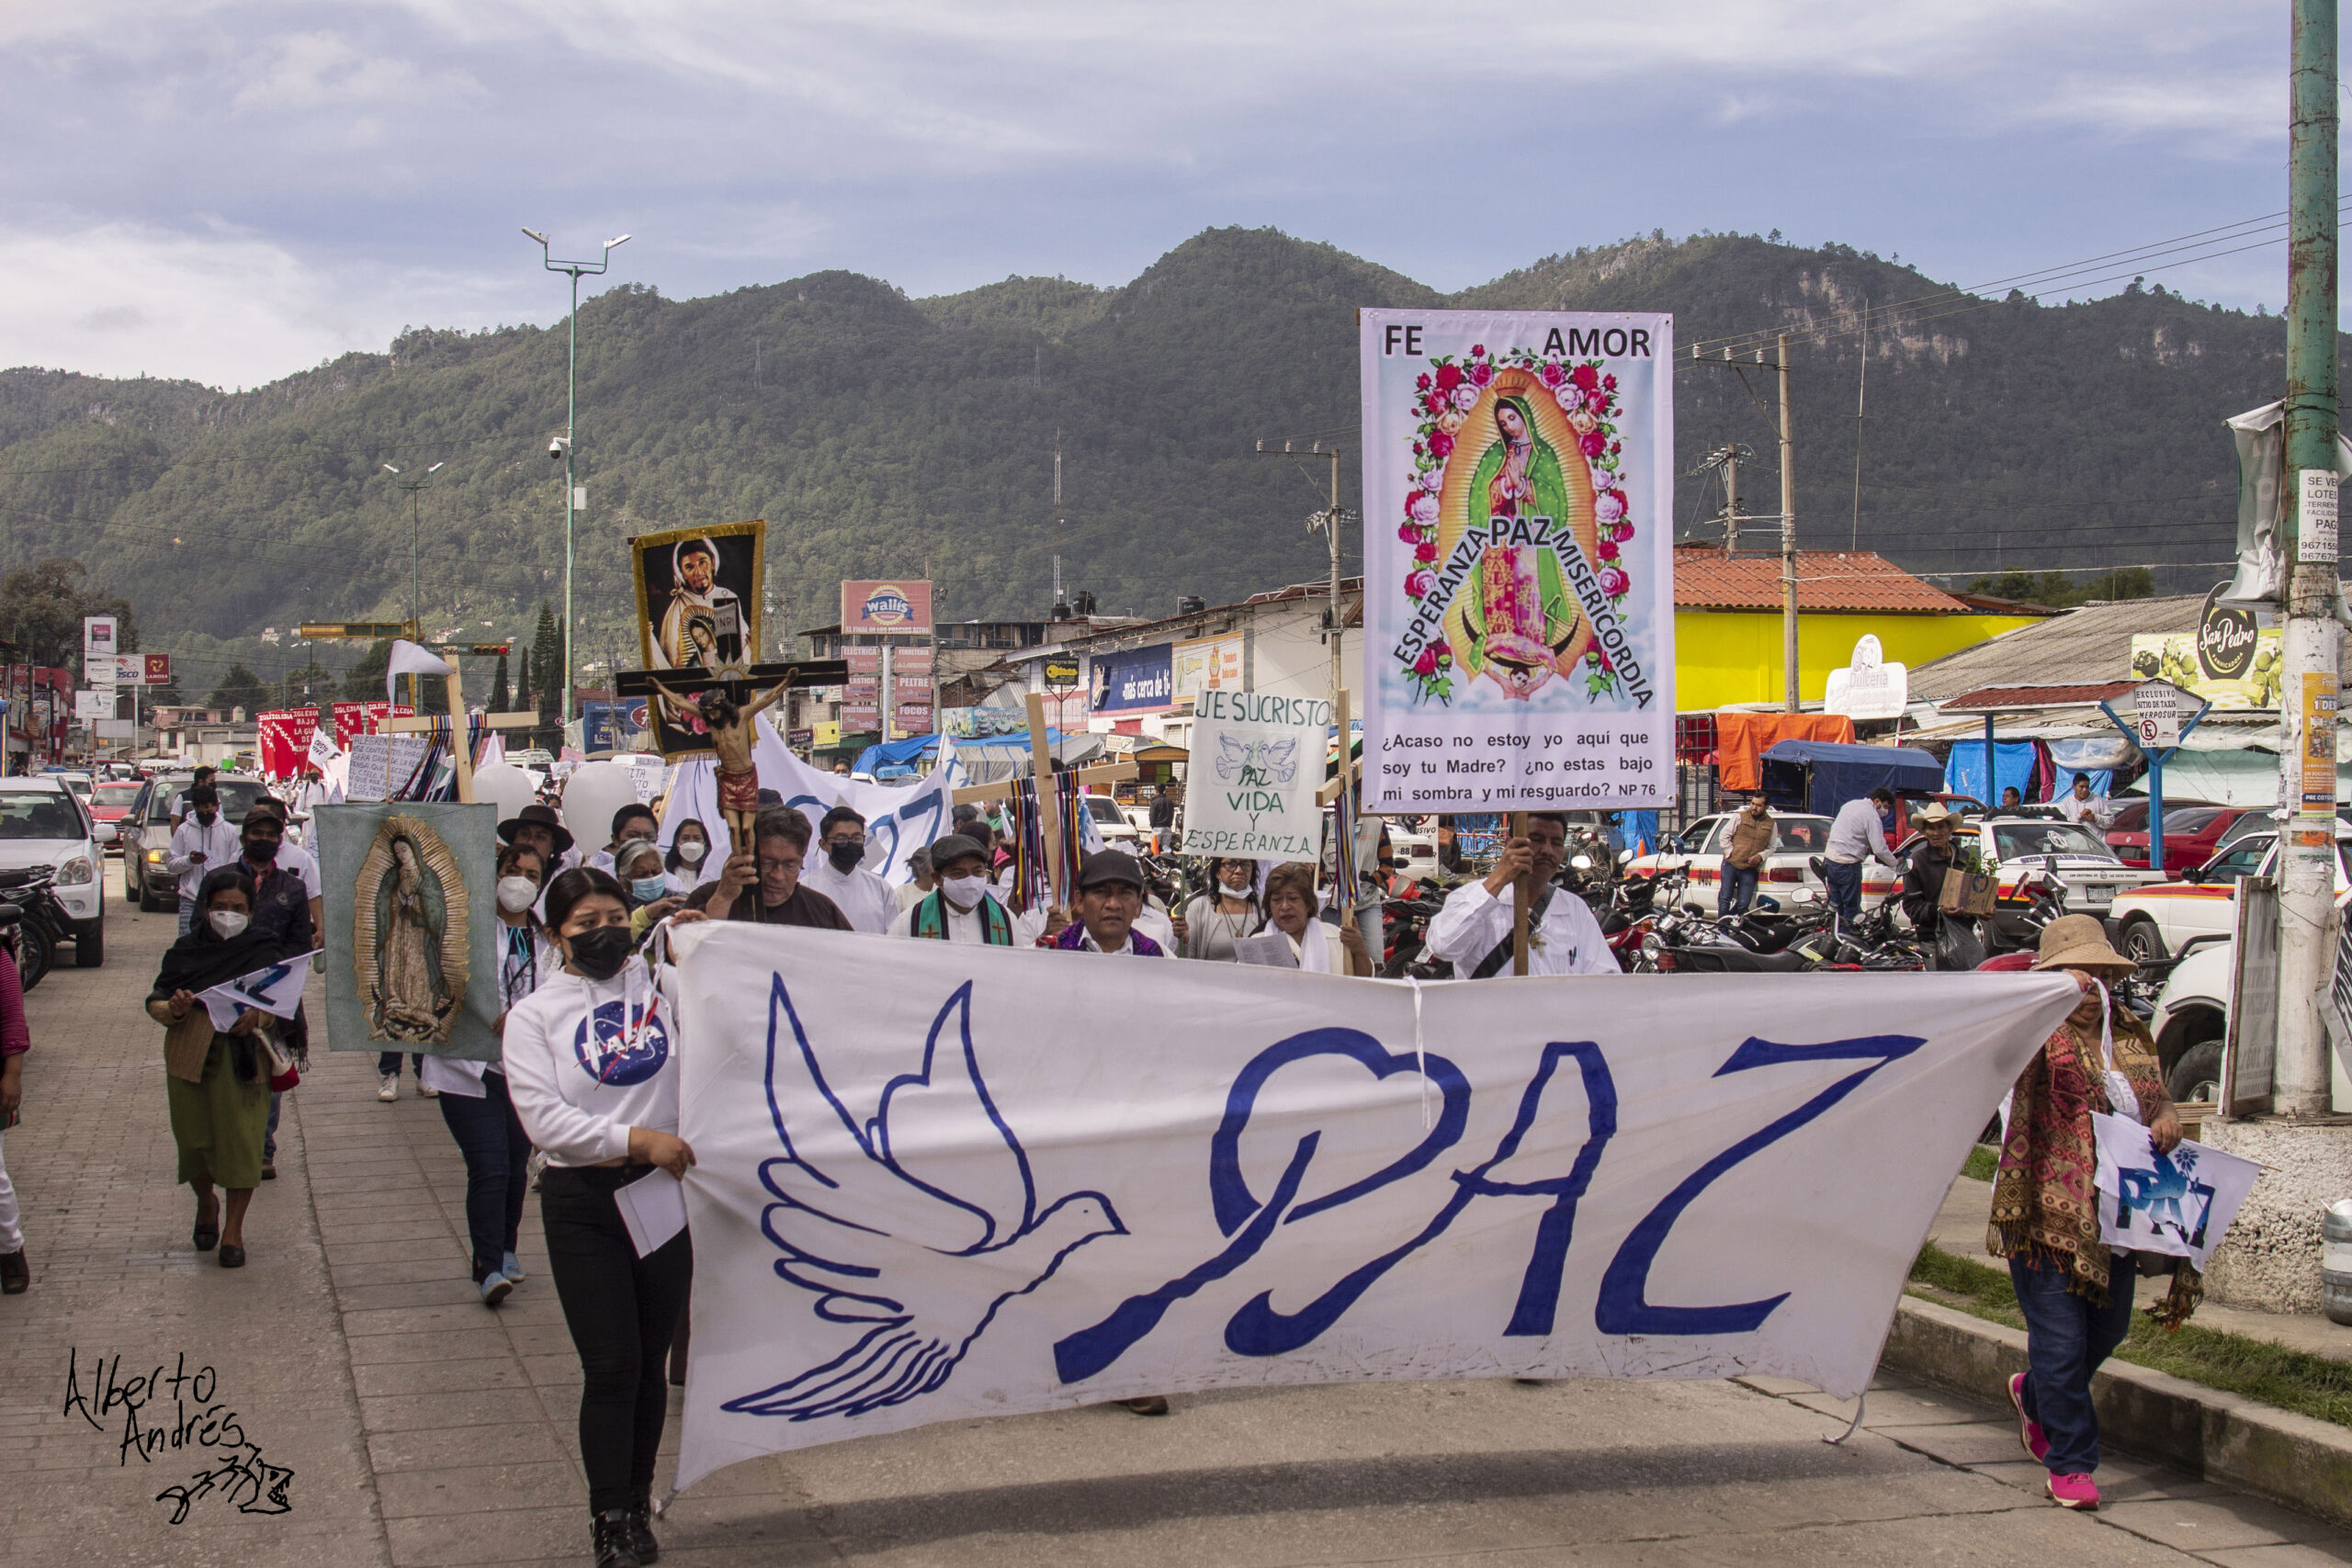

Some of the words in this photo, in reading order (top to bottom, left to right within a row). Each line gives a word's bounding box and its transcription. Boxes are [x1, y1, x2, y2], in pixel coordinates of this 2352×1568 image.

[1385, 325, 1423, 355] FE
[1543, 327, 1651, 357] AMOR
[2308, 476, 2323, 486] SE
[1490, 518, 1552, 546] PAZ
[1393, 526, 1489, 667] ESPERANZA
[1551, 530, 1655, 711] MISERICORDIA
[2199, 623, 2222, 651] San
[2217, 617, 2255, 653] Pedro
[2211, 651, 2245, 669] PANIFICADORA
[899, 677, 930, 687] PELTRE
[1136, 679, 1154, 699] cerca
[1154, 670, 1163, 697] de
[2136, 690, 2176, 699] EXCLUSIVO
[2137, 701, 2152, 709] SITIO
[2160, 700, 2177, 708] TAXIS
[334, 705, 361, 714] IGLESIA
[899, 706, 929, 716] FOCOS
[1195, 691, 1331, 727] JESUCRISTO
[2139, 710, 2177, 719] MERPOSUR
[1381, 733, 1443, 751] ¿Acaso
[1453, 735, 1474, 747] no
[1487, 733, 1532, 750] estoy
[1544, 734, 1563, 750] yo
[1577, 731, 1611, 749] aquí
[1620, 732, 1649, 748] que
[1238, 764, 1272, 788] PAZ
[1382, 762, 1411, 778] soy
[1420, 760, 1437, 773] tu
[1446, 759, 1507, 774] Madre?
[1525, 760, 1555, 774] ¿no
[1563, 758, 1605, 772] estas
[1619, 756, 1654, 773] bajo
[1227, 791, 1284, 815] VIDA
[1383, 787, 1402, 801] mi
[1411, 785, 1473, 800] sombra
[1482, 788, 1492, 803] y
[1497, 785, 1515, 799] mi
[1521, 783, 1611, 801] resguardo?
[1618, 784, 1638, 796] NP
[1640, 783, 1657, 796] 76
[1249, 812, 1261, 831] Y
[1182, 829, 1315, 856] ESPERANZA
[1052, 1025, 1929, 1384] PAZ
